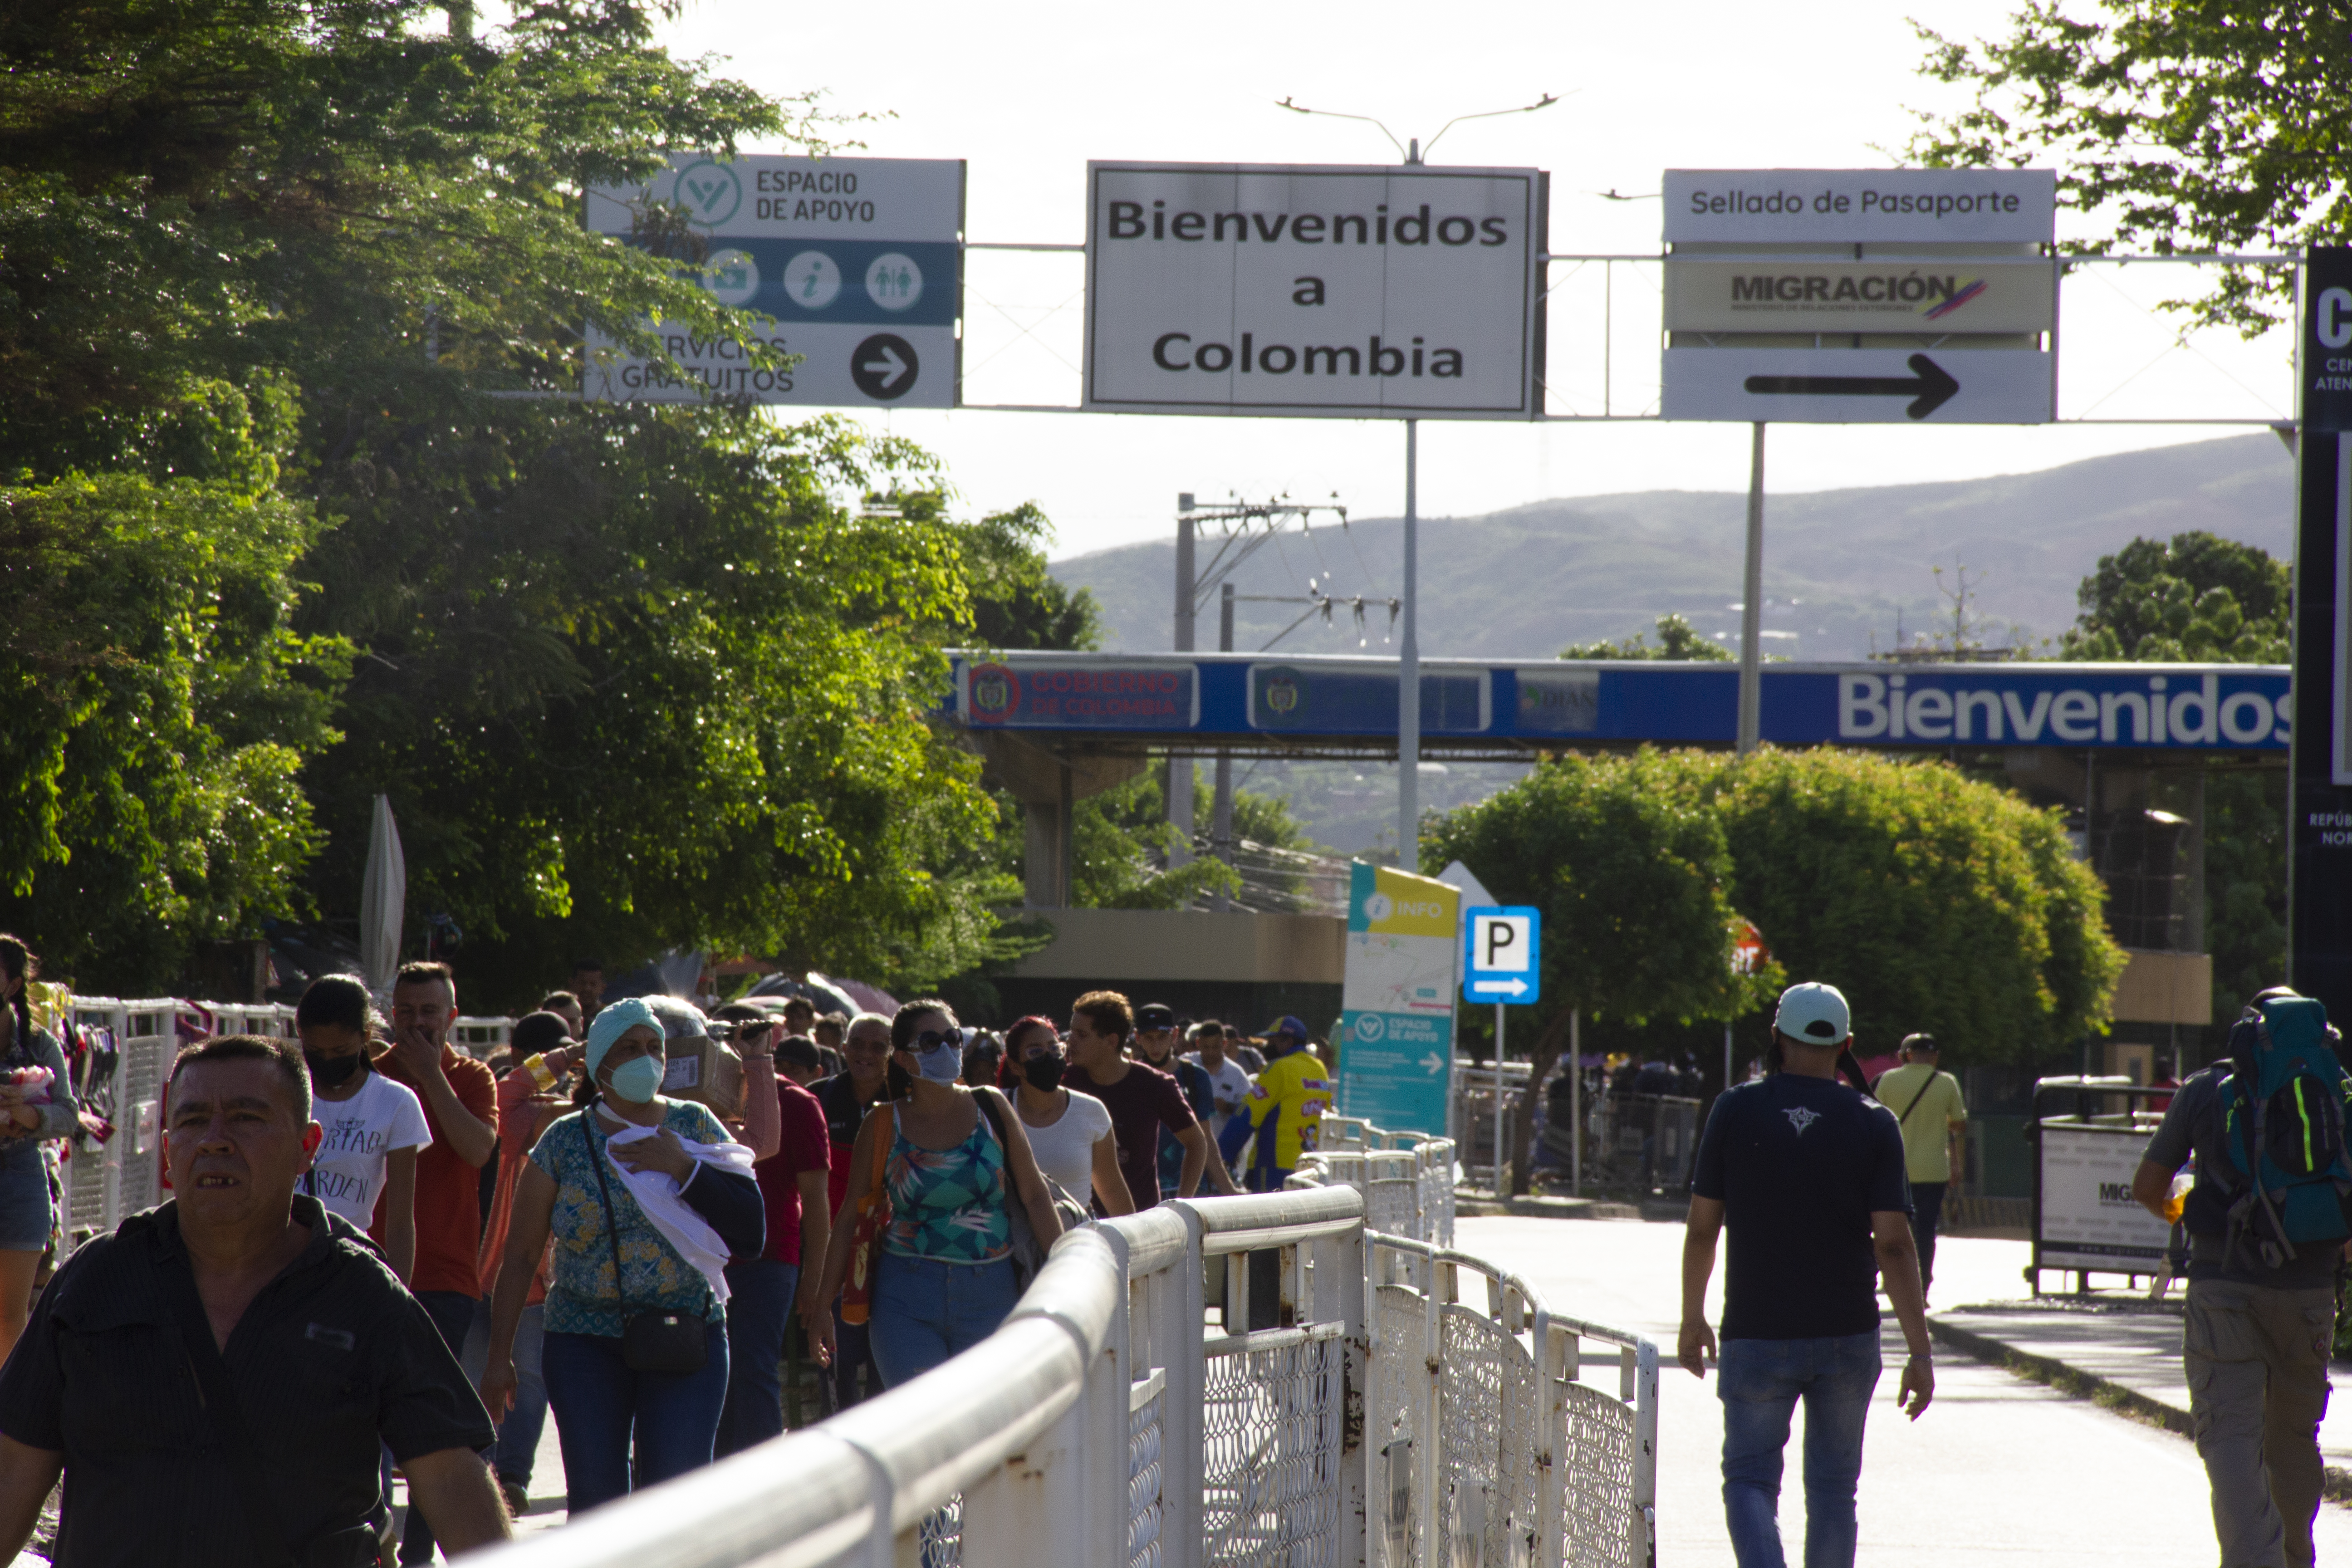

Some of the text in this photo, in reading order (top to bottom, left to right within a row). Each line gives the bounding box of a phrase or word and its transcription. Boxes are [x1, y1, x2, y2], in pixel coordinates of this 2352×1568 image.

[757, 170, 857, 194] ESPACIO
[757, 199, 875, 222] DE APOYO
[1690, 189, 2020, 219] Sellado de Pasaporte
[1108, 200, 1507, 246] Bienvenidos
[1292, 275, 1325, 306] a
[1731, 271, 1956, 303] MIGRACIÓN
[1152, 332, 1464, 377] Colombia
[1032, 671, 1178, 693] GOBIERNO
[1031, 698, 1176, 716] DE COLOMBIA
[1397, 901, 1443, 918] INFO
[1487, 921, 1515, 966] P
